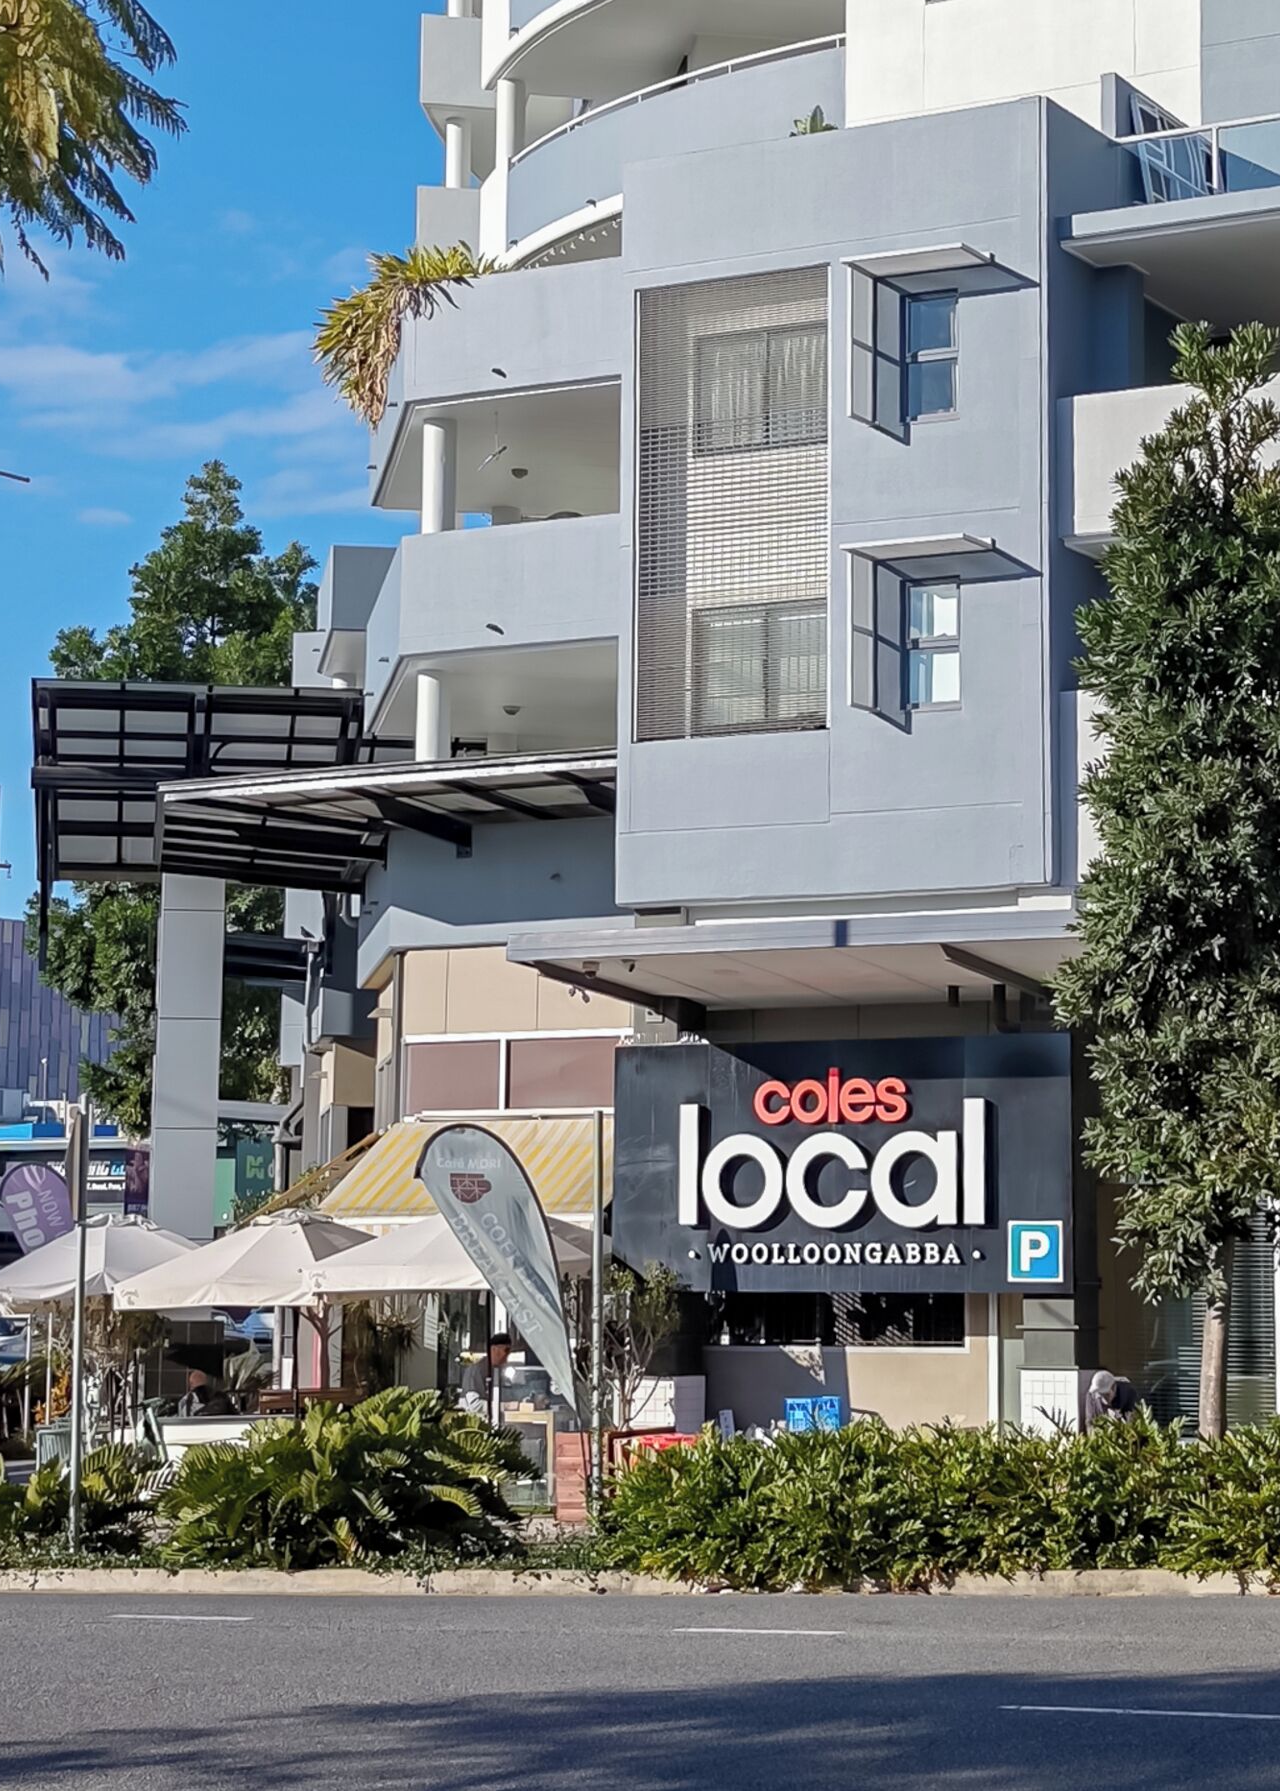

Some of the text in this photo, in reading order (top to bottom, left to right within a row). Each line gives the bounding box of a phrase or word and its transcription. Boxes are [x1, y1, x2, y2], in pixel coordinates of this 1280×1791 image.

[753, 1067, 908, 1125] coles
[467, 1158, 501, 1170] MORI
[678, 1098, 985, 1229] local
[5, 1191, 46, 1248] Pho
[37, 1189, 65, 1227] NOW
[706, 1242, 961, 1265] WOOLLOONGABBA
[1019, 1230, 1050, 1272] P
